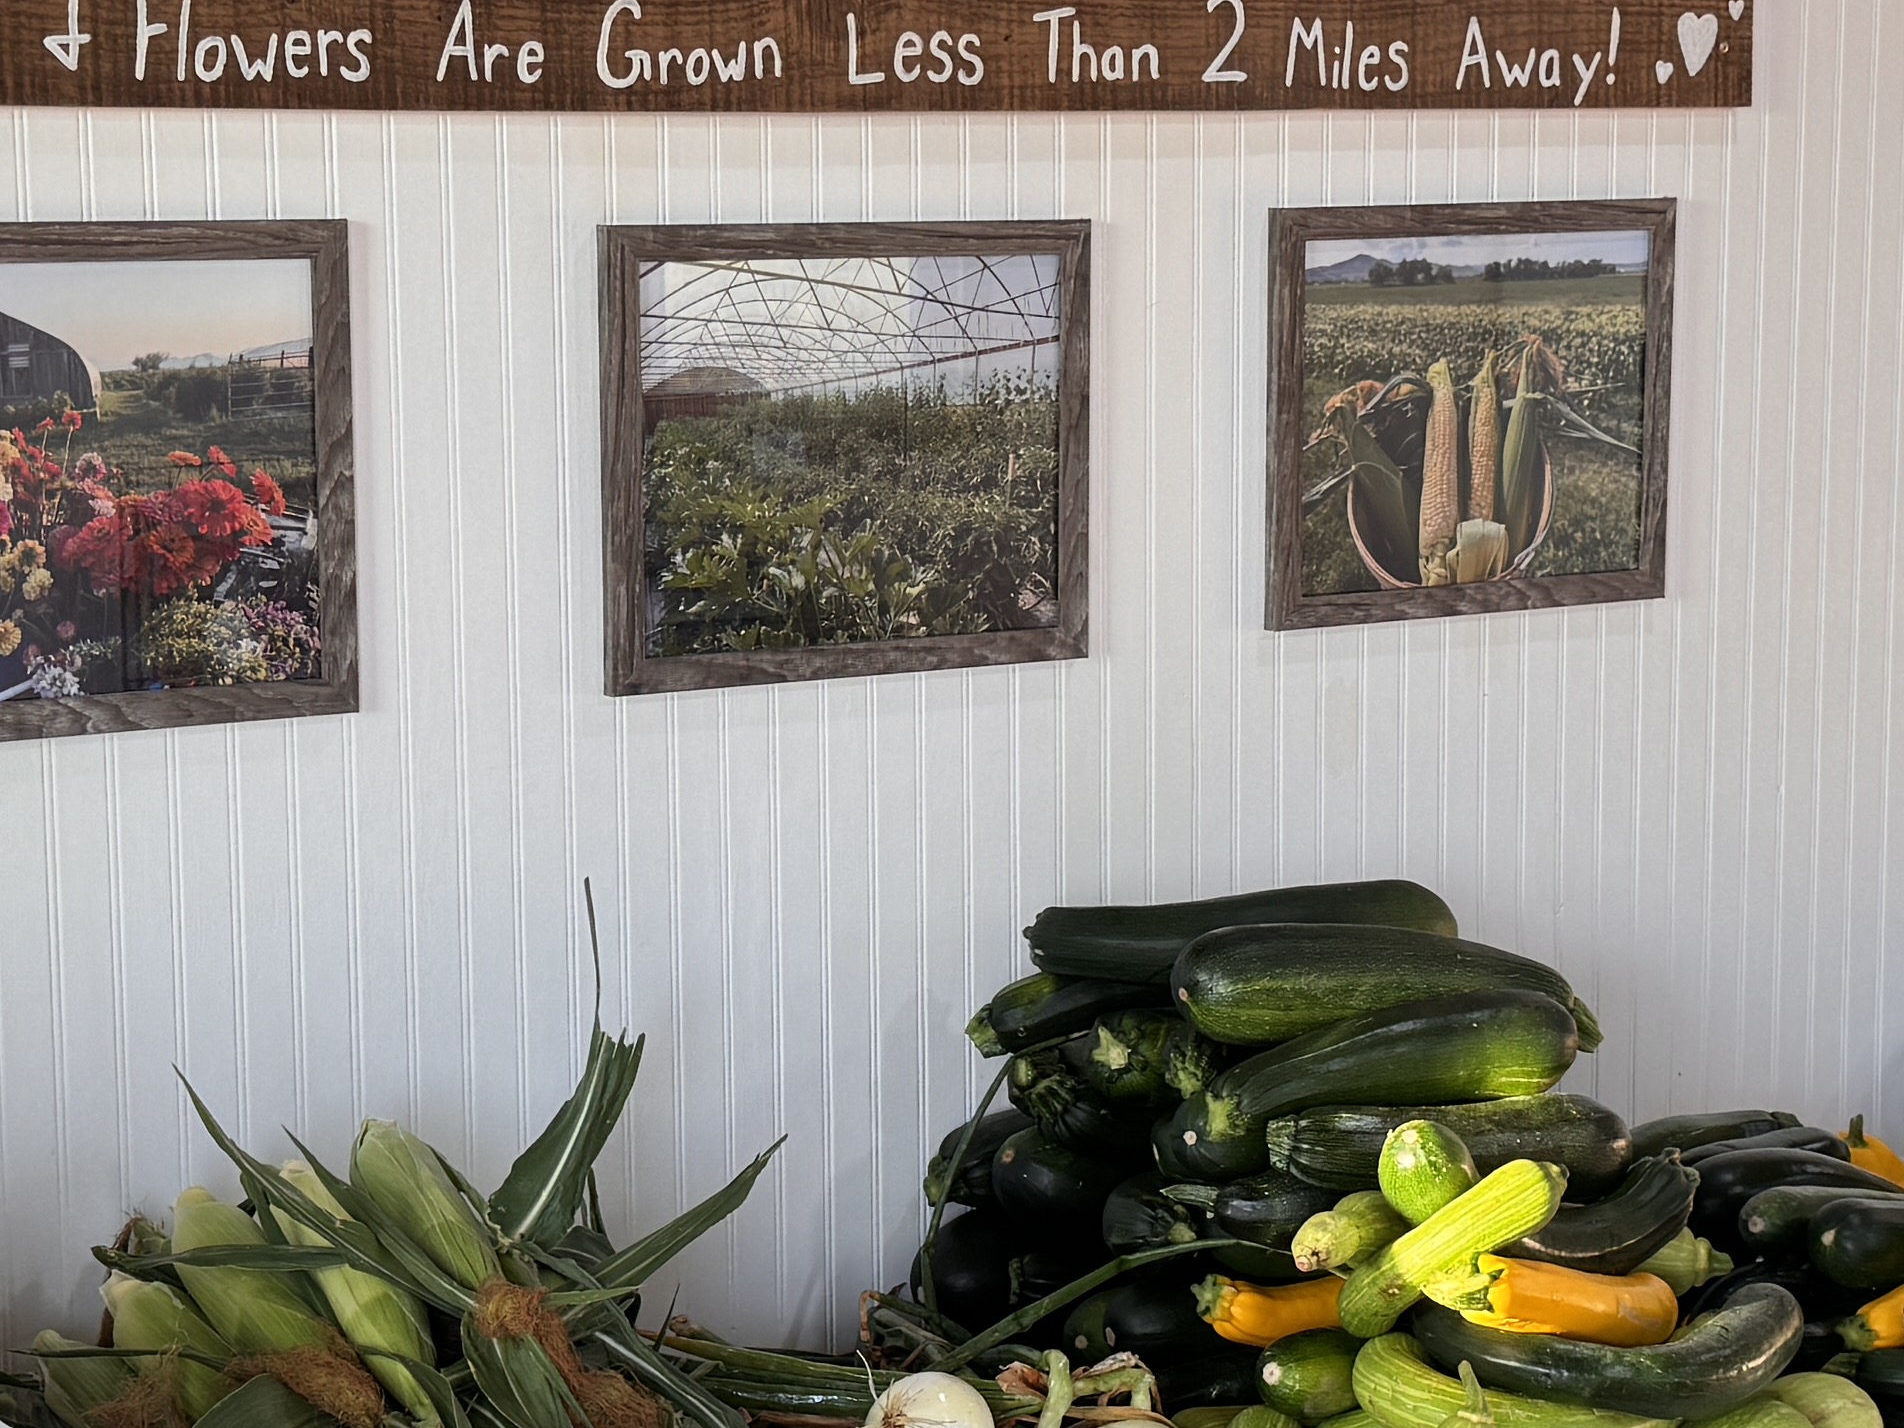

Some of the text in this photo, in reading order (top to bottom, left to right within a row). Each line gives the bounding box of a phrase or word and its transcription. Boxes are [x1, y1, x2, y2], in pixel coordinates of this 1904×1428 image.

[846, 11, 985, 87] Less
[1031, 6, 1161, 85] Than
[1284, 16, 1410, 93] Miles
[1455, 5, 1621, 108] Away!
